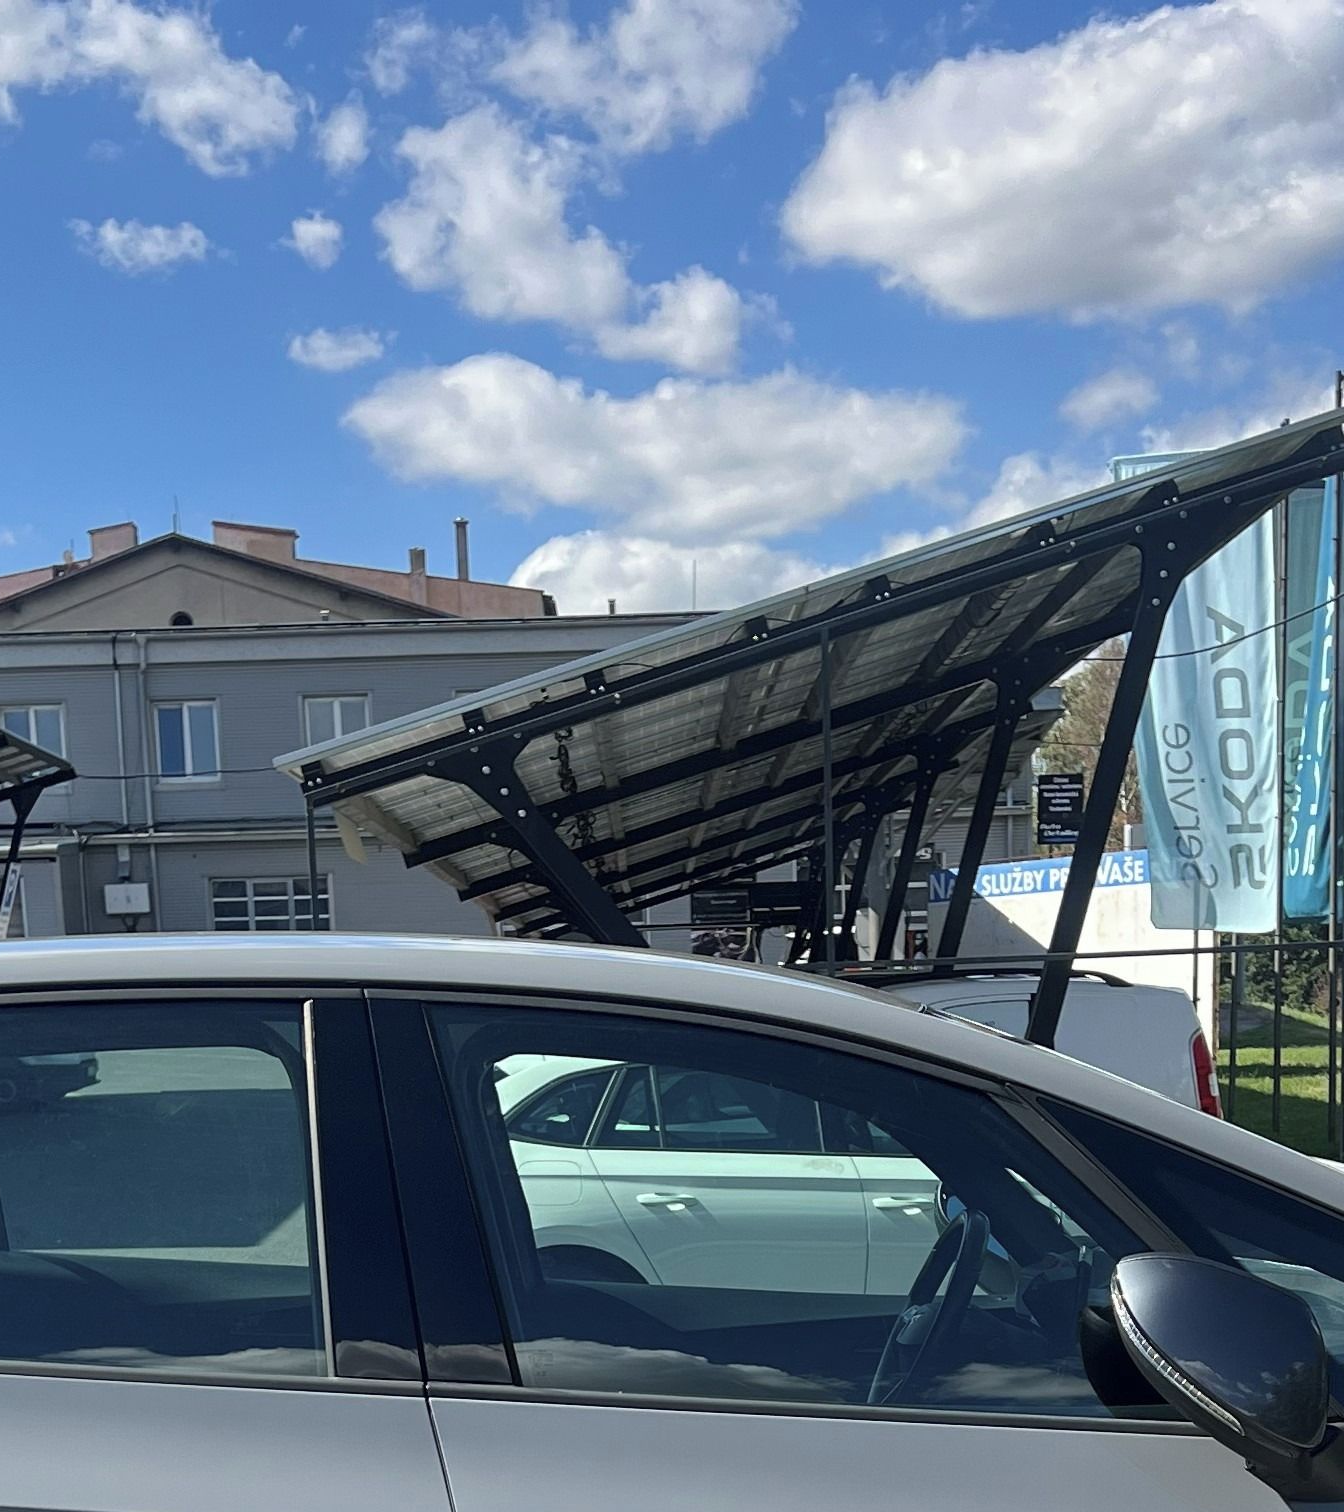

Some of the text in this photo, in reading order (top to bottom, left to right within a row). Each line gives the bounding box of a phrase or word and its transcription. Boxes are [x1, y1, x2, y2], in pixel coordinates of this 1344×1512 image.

[982, 866, 1045, 896] SLUŽBY
[1049, 867, 1069, 889] PR
[1097, 855, 1144, 884] VAŠE
